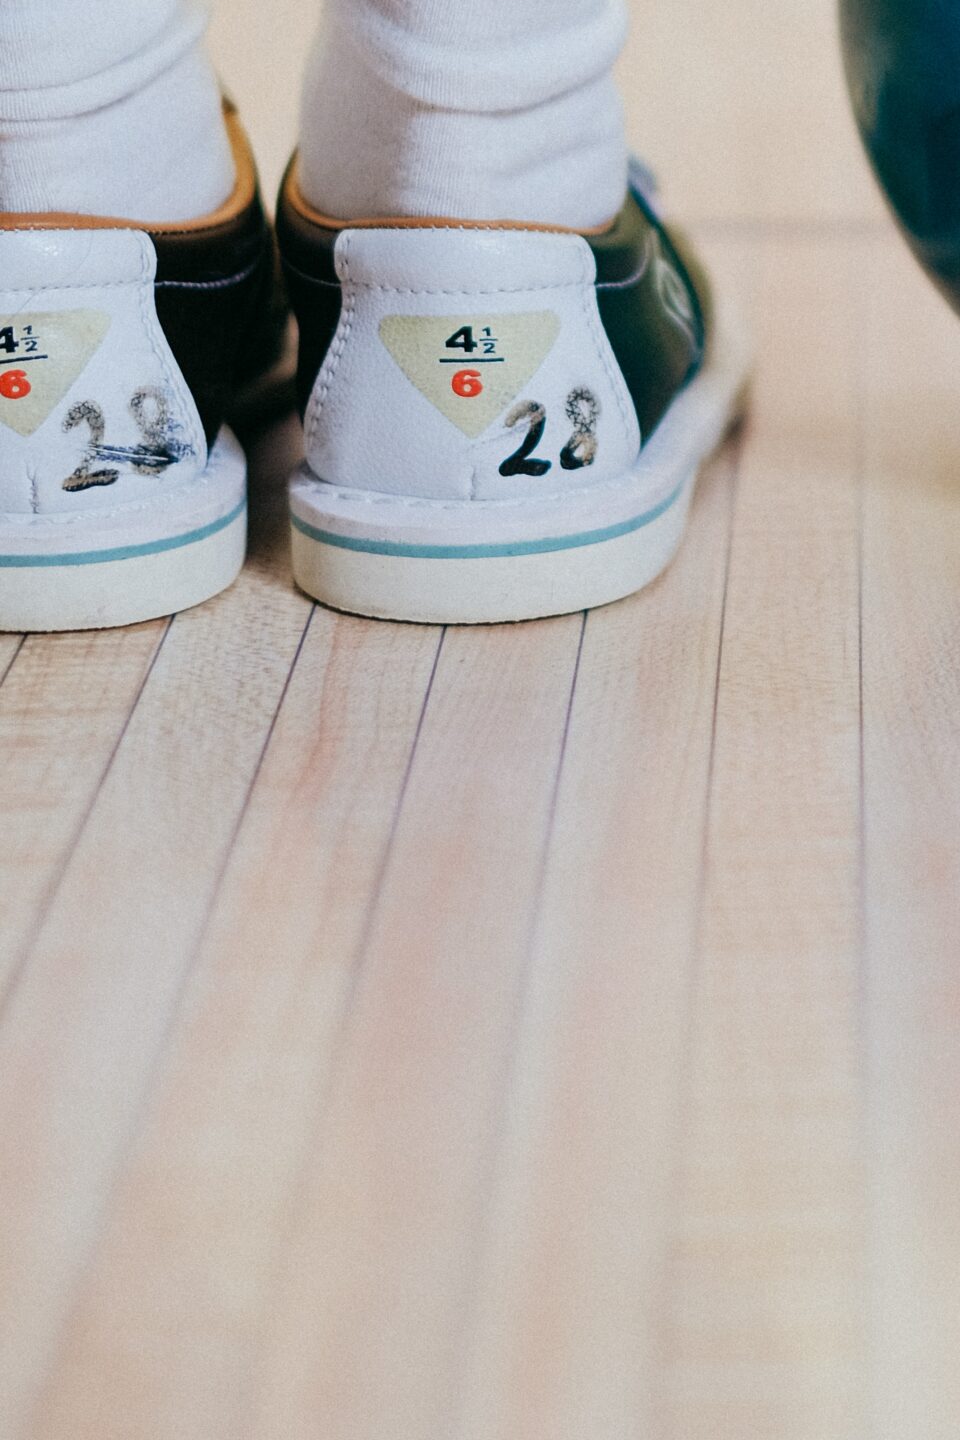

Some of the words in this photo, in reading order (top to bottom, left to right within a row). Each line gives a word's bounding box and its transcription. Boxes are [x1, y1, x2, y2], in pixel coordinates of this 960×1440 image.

[0, 370, 31, 399] 6
[451, 369, 483, 397] 6
[499, 387, 598, 476] 28
